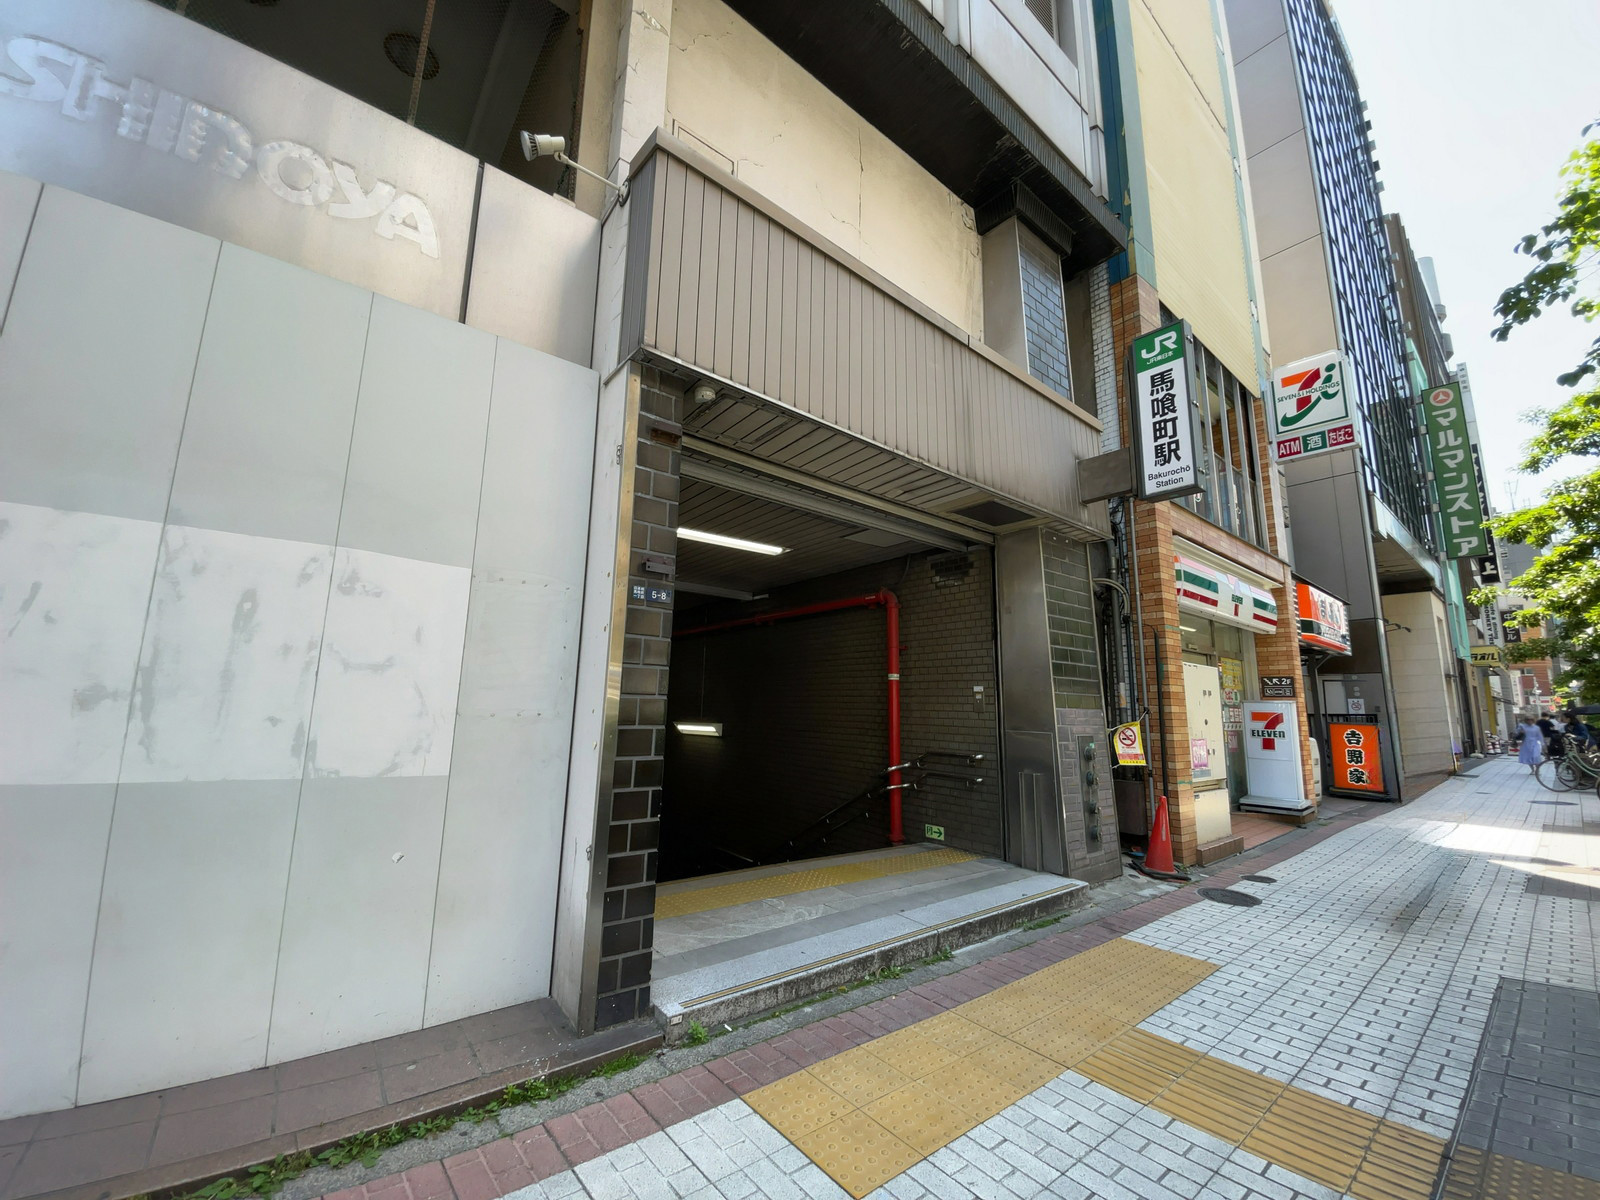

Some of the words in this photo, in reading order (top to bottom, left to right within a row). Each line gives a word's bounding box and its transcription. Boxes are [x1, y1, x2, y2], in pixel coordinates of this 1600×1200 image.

[1141, 331, 1178, 358] JR
[1306, 381, 1340, 395] HOLDINGS
[1149, 368, 1181, 467] 馬喰町駅
[1306, 434, 1322, 450] 酒
[1329, 428, 1353, 444] たばこ
[1279, 440, 1301, 456] ATM
[1156, 477, 1184, 488] Station
[1432, 407, 1479, 556] マルマンストア
[651, 590, 667, 600] 5-8
[1344, 729, 1367, 785] 吉野家
